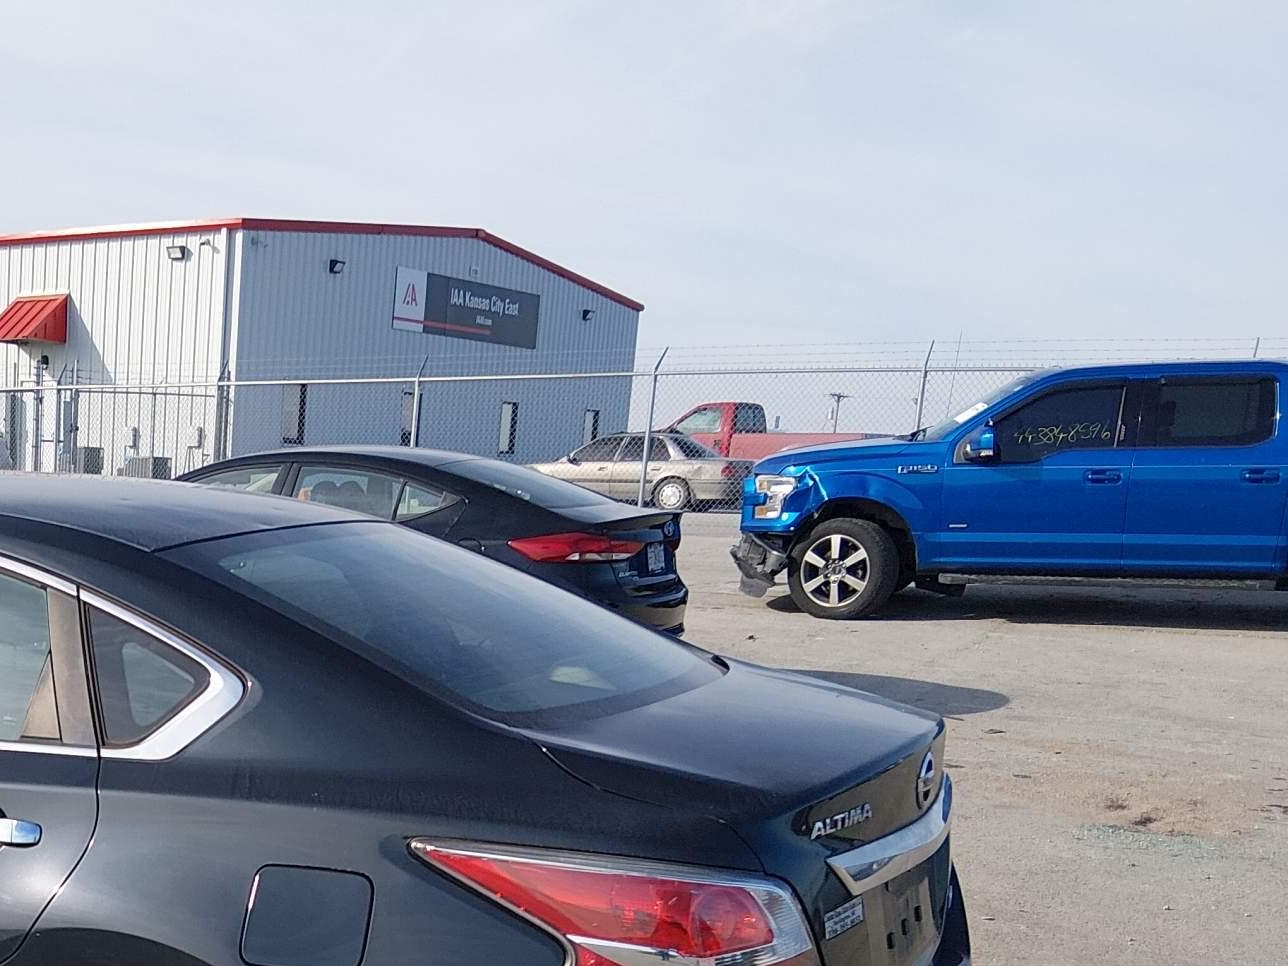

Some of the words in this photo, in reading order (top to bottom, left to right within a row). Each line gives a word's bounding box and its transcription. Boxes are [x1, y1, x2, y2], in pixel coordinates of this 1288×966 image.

[450, 288, 464, 307] IAA
[465, 291, 491, 312] Kansas
[491, 296, 504, 318] City
[505, 300, 520, 316] East
[810, 803, 873, 840] ALTIMA
